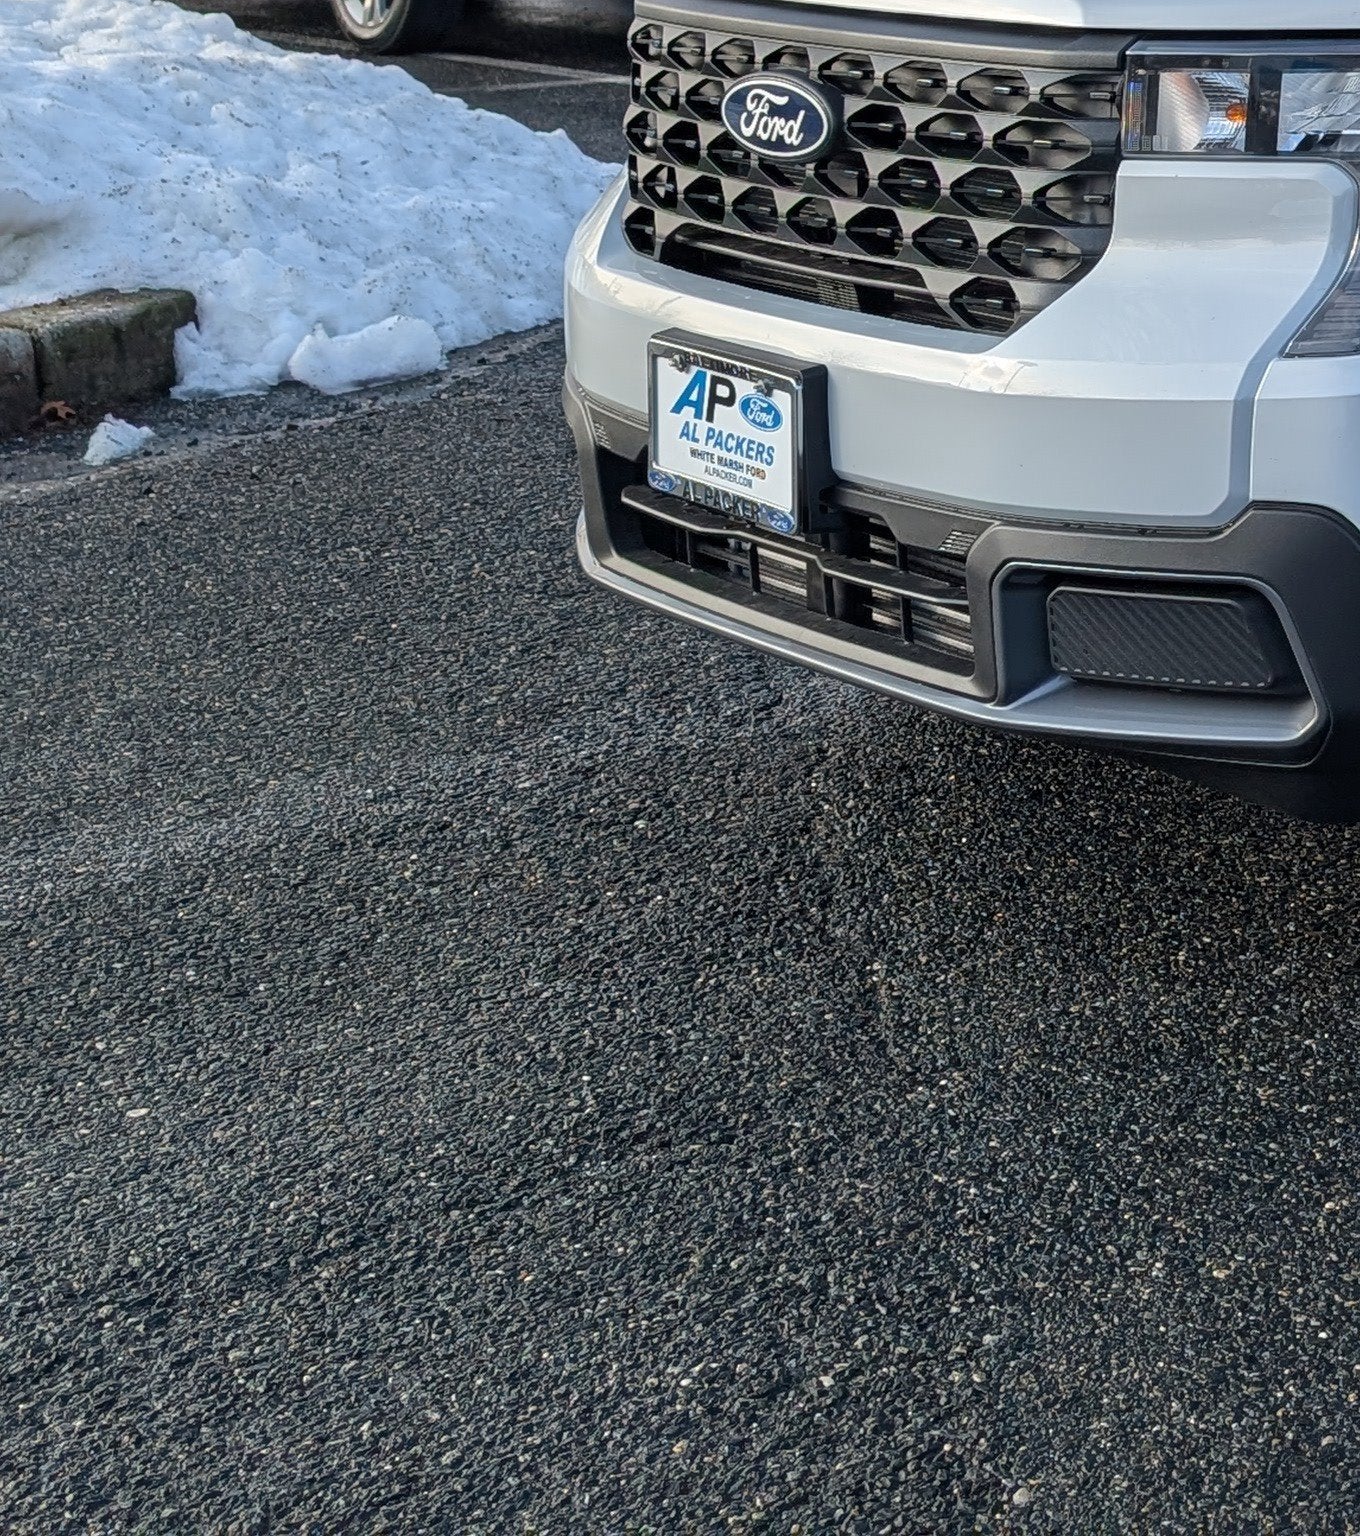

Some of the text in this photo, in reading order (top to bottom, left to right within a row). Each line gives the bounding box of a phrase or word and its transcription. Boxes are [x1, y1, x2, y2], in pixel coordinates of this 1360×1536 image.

[740, 88, 805, 146] Ford
[670, 369, 736, 423] AP
[747, 398, 775, 427] Ford
[679, 421, 775, 466] AL PACKERS
[690, 447, 766, 480] WHITE MARSH FORD
